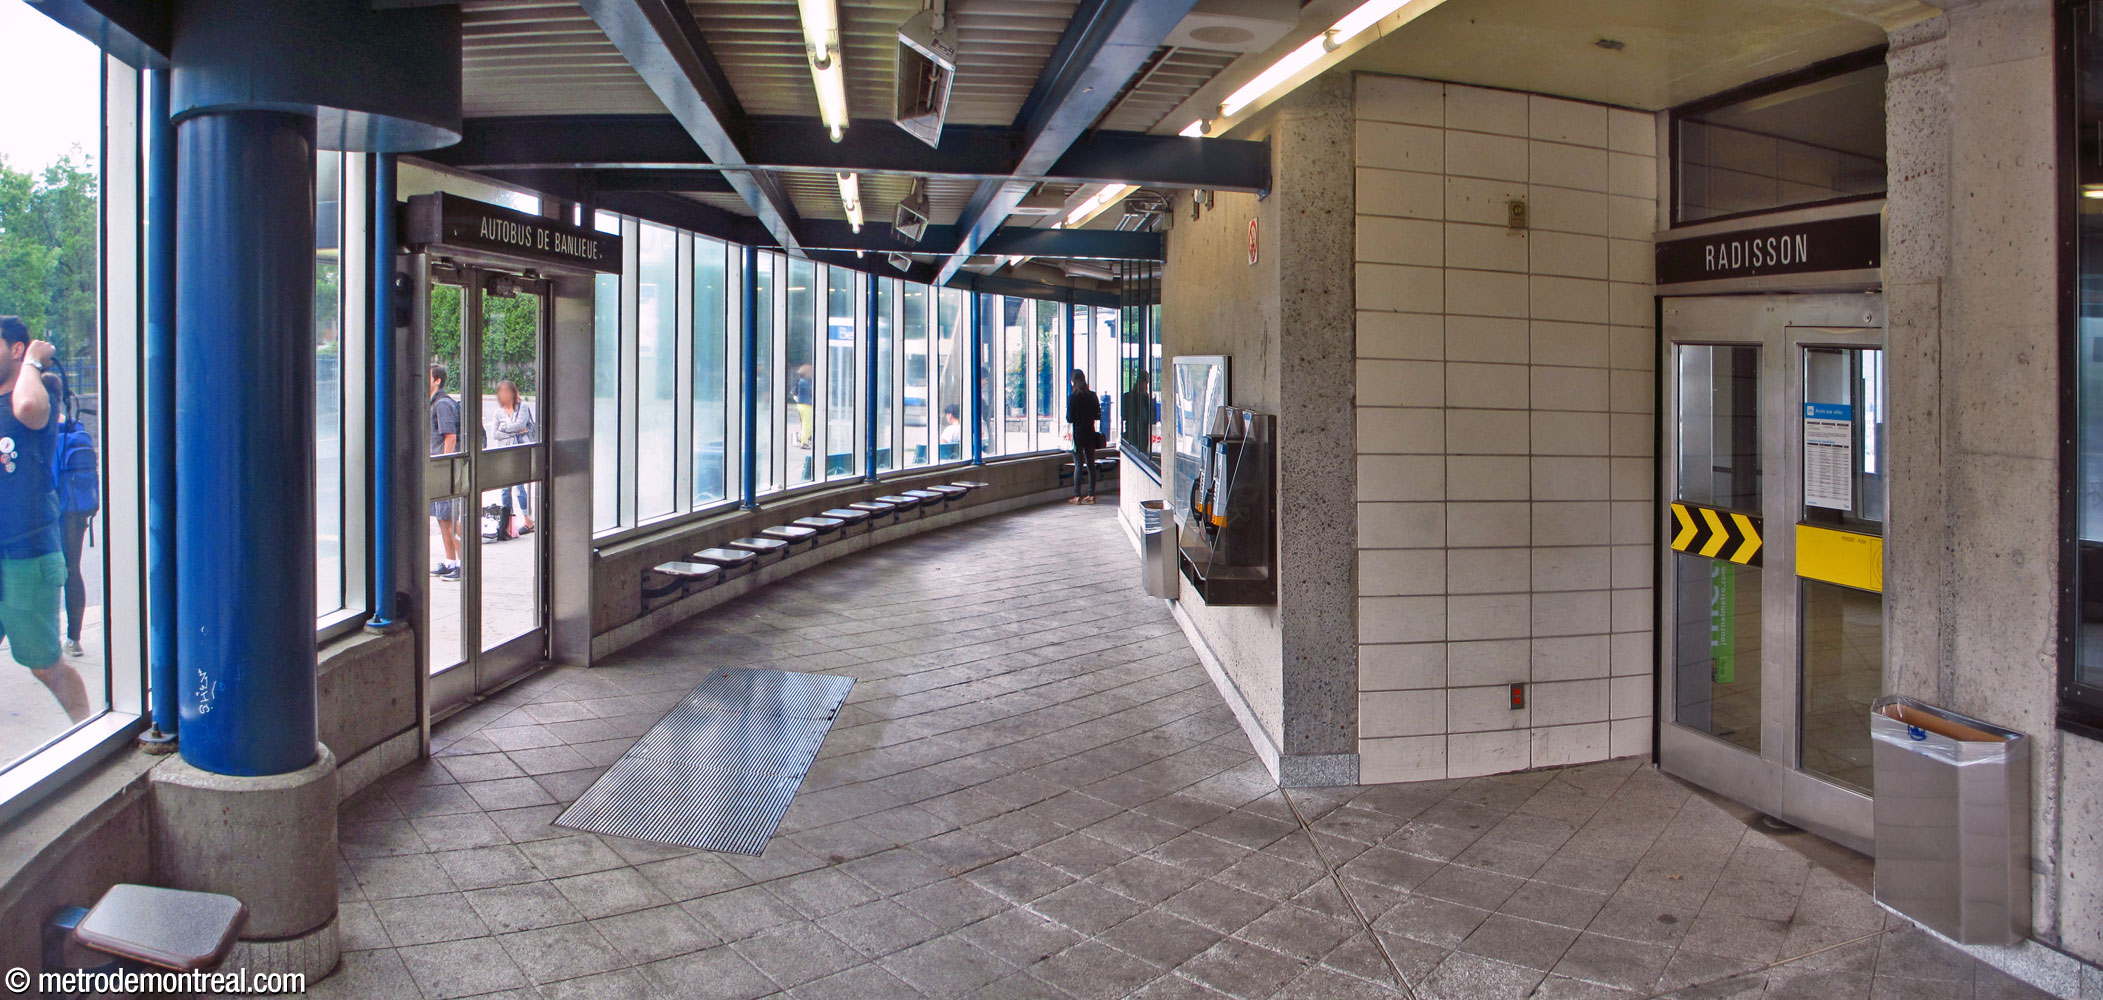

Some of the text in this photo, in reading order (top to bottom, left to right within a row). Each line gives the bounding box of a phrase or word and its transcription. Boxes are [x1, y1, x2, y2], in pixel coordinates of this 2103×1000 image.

[480, 216, 598, 260] AUTOBUS DE BANLIEUE
[1705, 233, 1807, 271] RADISSON
[1719, 566, 1728, 647] journalmetro.com
